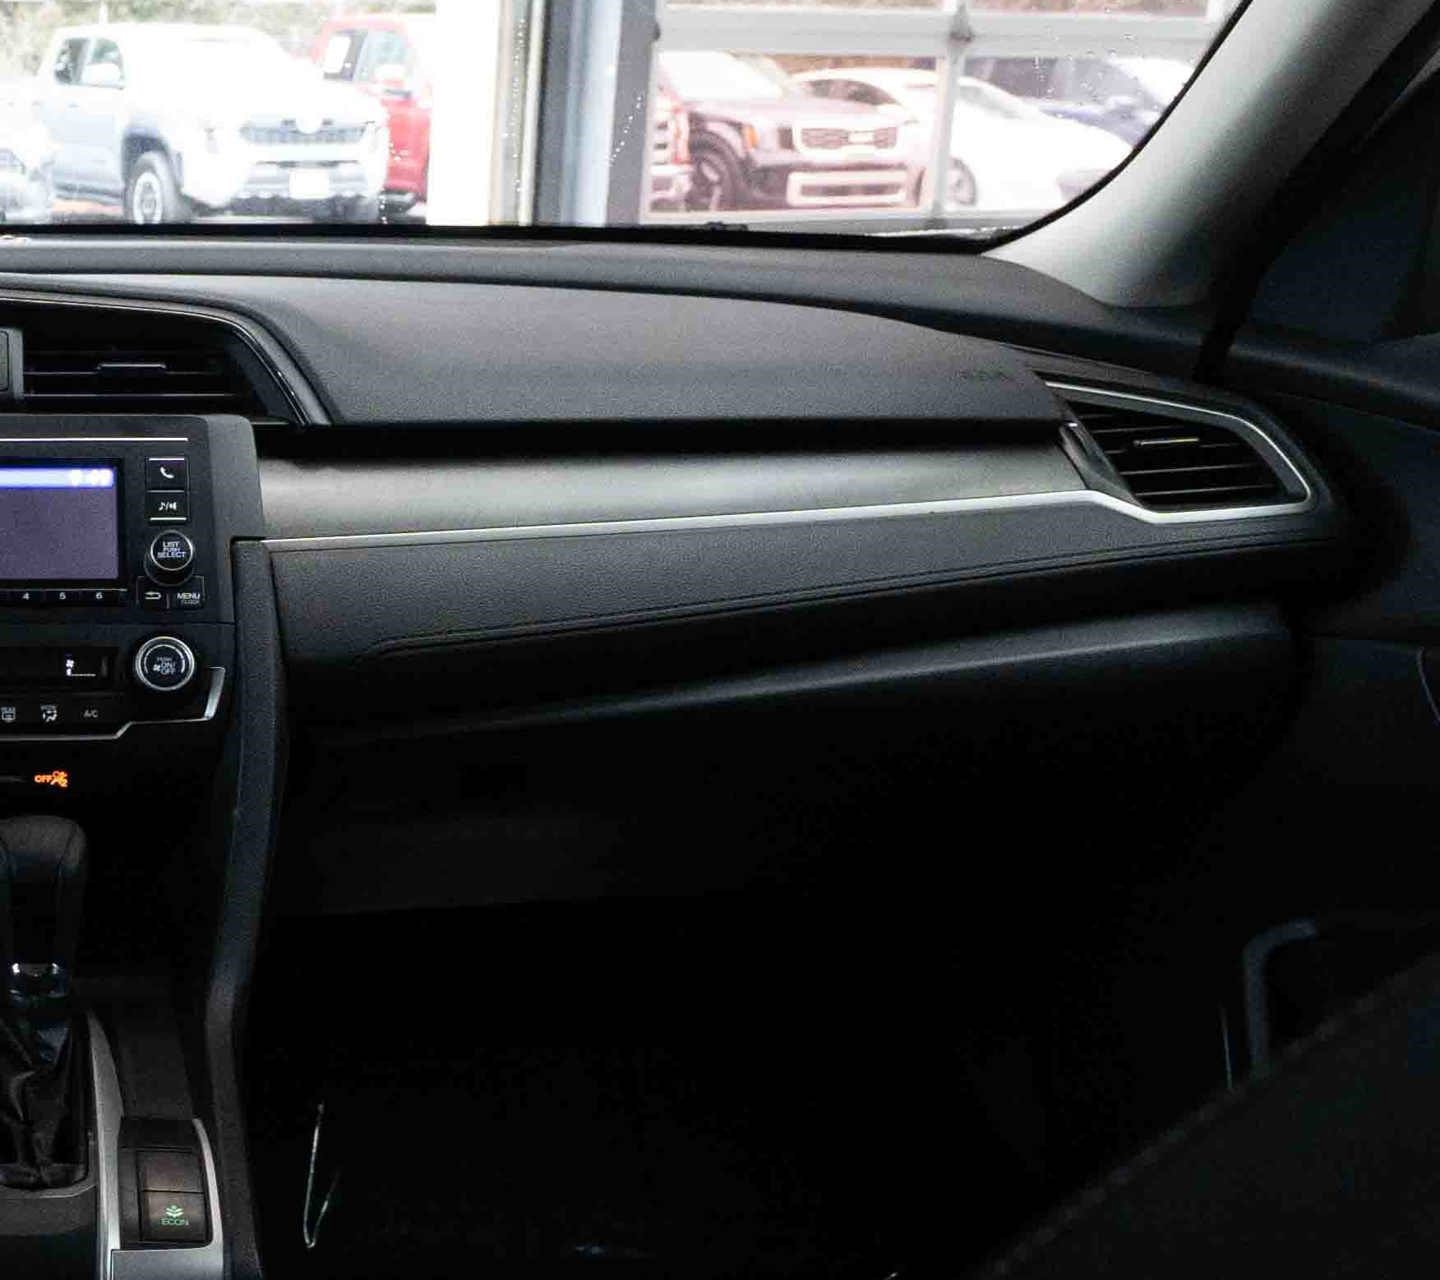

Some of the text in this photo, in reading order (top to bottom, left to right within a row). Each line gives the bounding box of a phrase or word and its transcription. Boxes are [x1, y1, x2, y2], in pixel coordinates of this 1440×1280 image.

[22, 592, 30, 601] 4
[58, 592, 66, 601] 5
[96, 592, 104, 601] 6
[177, 592, 201, 600] MENU
[34, 774, 52, 783] OFF
